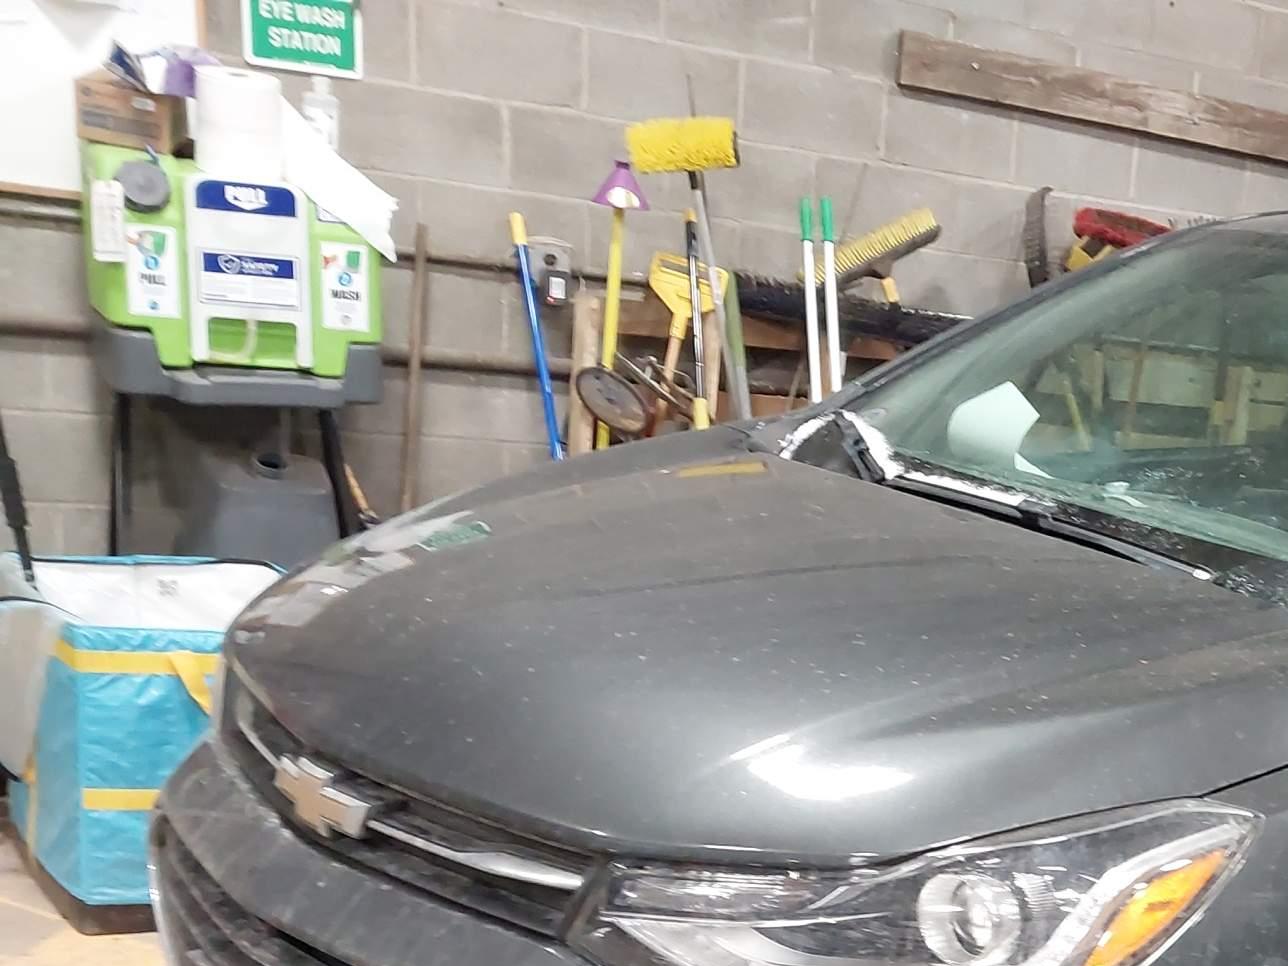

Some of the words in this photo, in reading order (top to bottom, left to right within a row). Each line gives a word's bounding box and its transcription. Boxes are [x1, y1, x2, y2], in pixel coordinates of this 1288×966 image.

[258, 0, 296, 21] EYE
[295, 2, 345, 29] WASH
[267, 25, 341, 56] STATION
[223, 185, 267, 204] PULL
[330, 289, 361, 301] WASH
